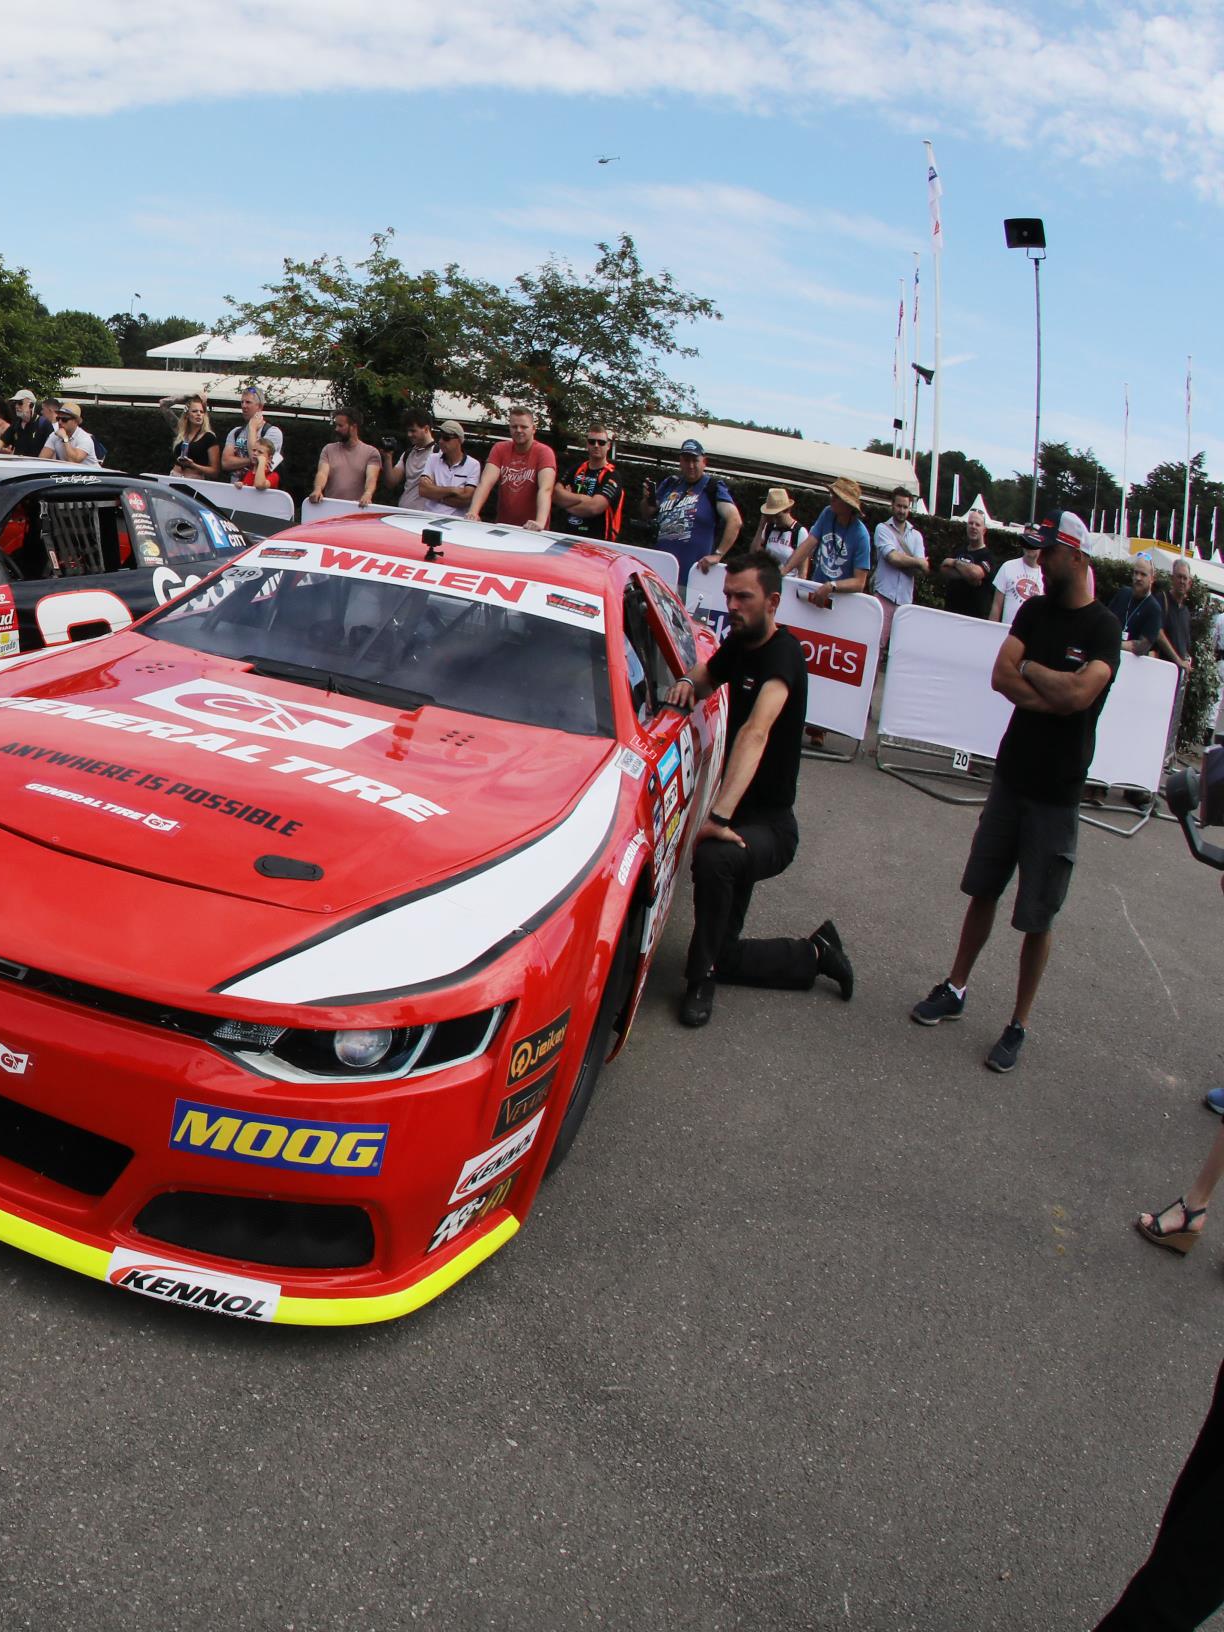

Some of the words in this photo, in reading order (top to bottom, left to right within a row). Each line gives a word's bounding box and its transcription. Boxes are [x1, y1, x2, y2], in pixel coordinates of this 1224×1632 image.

[228, 534, 247, 547] CITY
[228, 569, 255, 578] 249
[320, 547, 528, 603] WHELEN
[955, 753, 968, 767] 20
[25, 783, 104, 808] GENERAL
[101, 803, 146, 821] TIRE
[135, 773, 169, 792] IS
[164, 780, 304, 837] POSSIBLE
[269, 755, 450, 823] TIRE
[173, 1110, 386, 1168] MOOG
[464, 1129, 535, 1191] KENNOL
[121, 1269, 269, 1318] KENNOL
